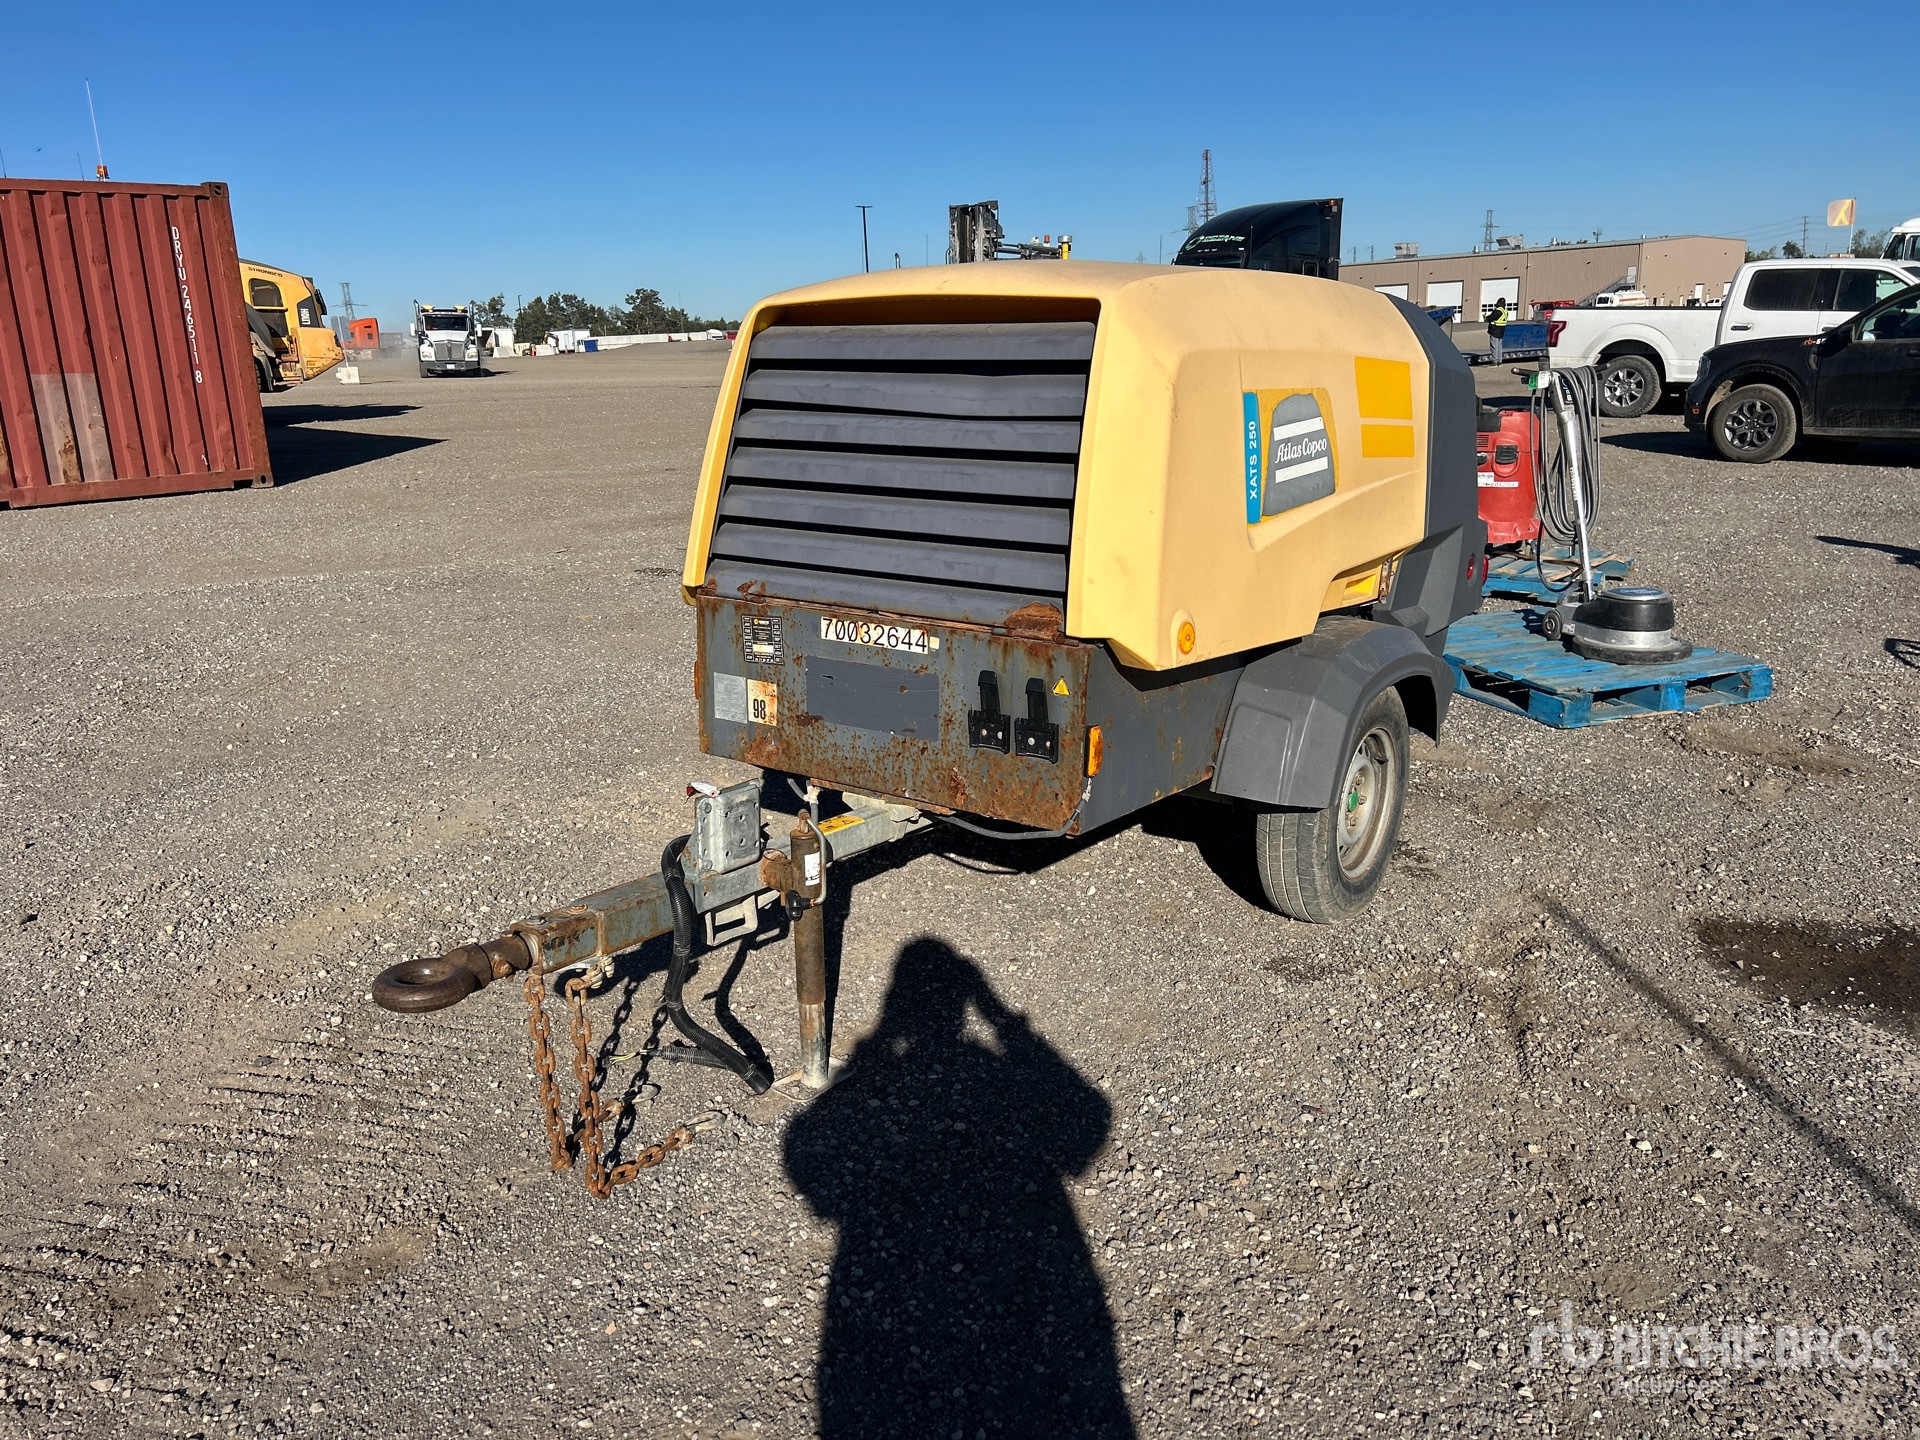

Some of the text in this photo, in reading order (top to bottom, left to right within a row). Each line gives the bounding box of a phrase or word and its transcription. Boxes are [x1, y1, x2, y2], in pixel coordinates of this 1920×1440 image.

[171, 226, 203, 384] DRYU 246511 8
[1248, 421, 1258, 500] XATS 250
[1275, 438, 1327, 464] Atlas Copco
[822, 617, 927, 652] 70032644
[753, 698, 766, 720] 98
